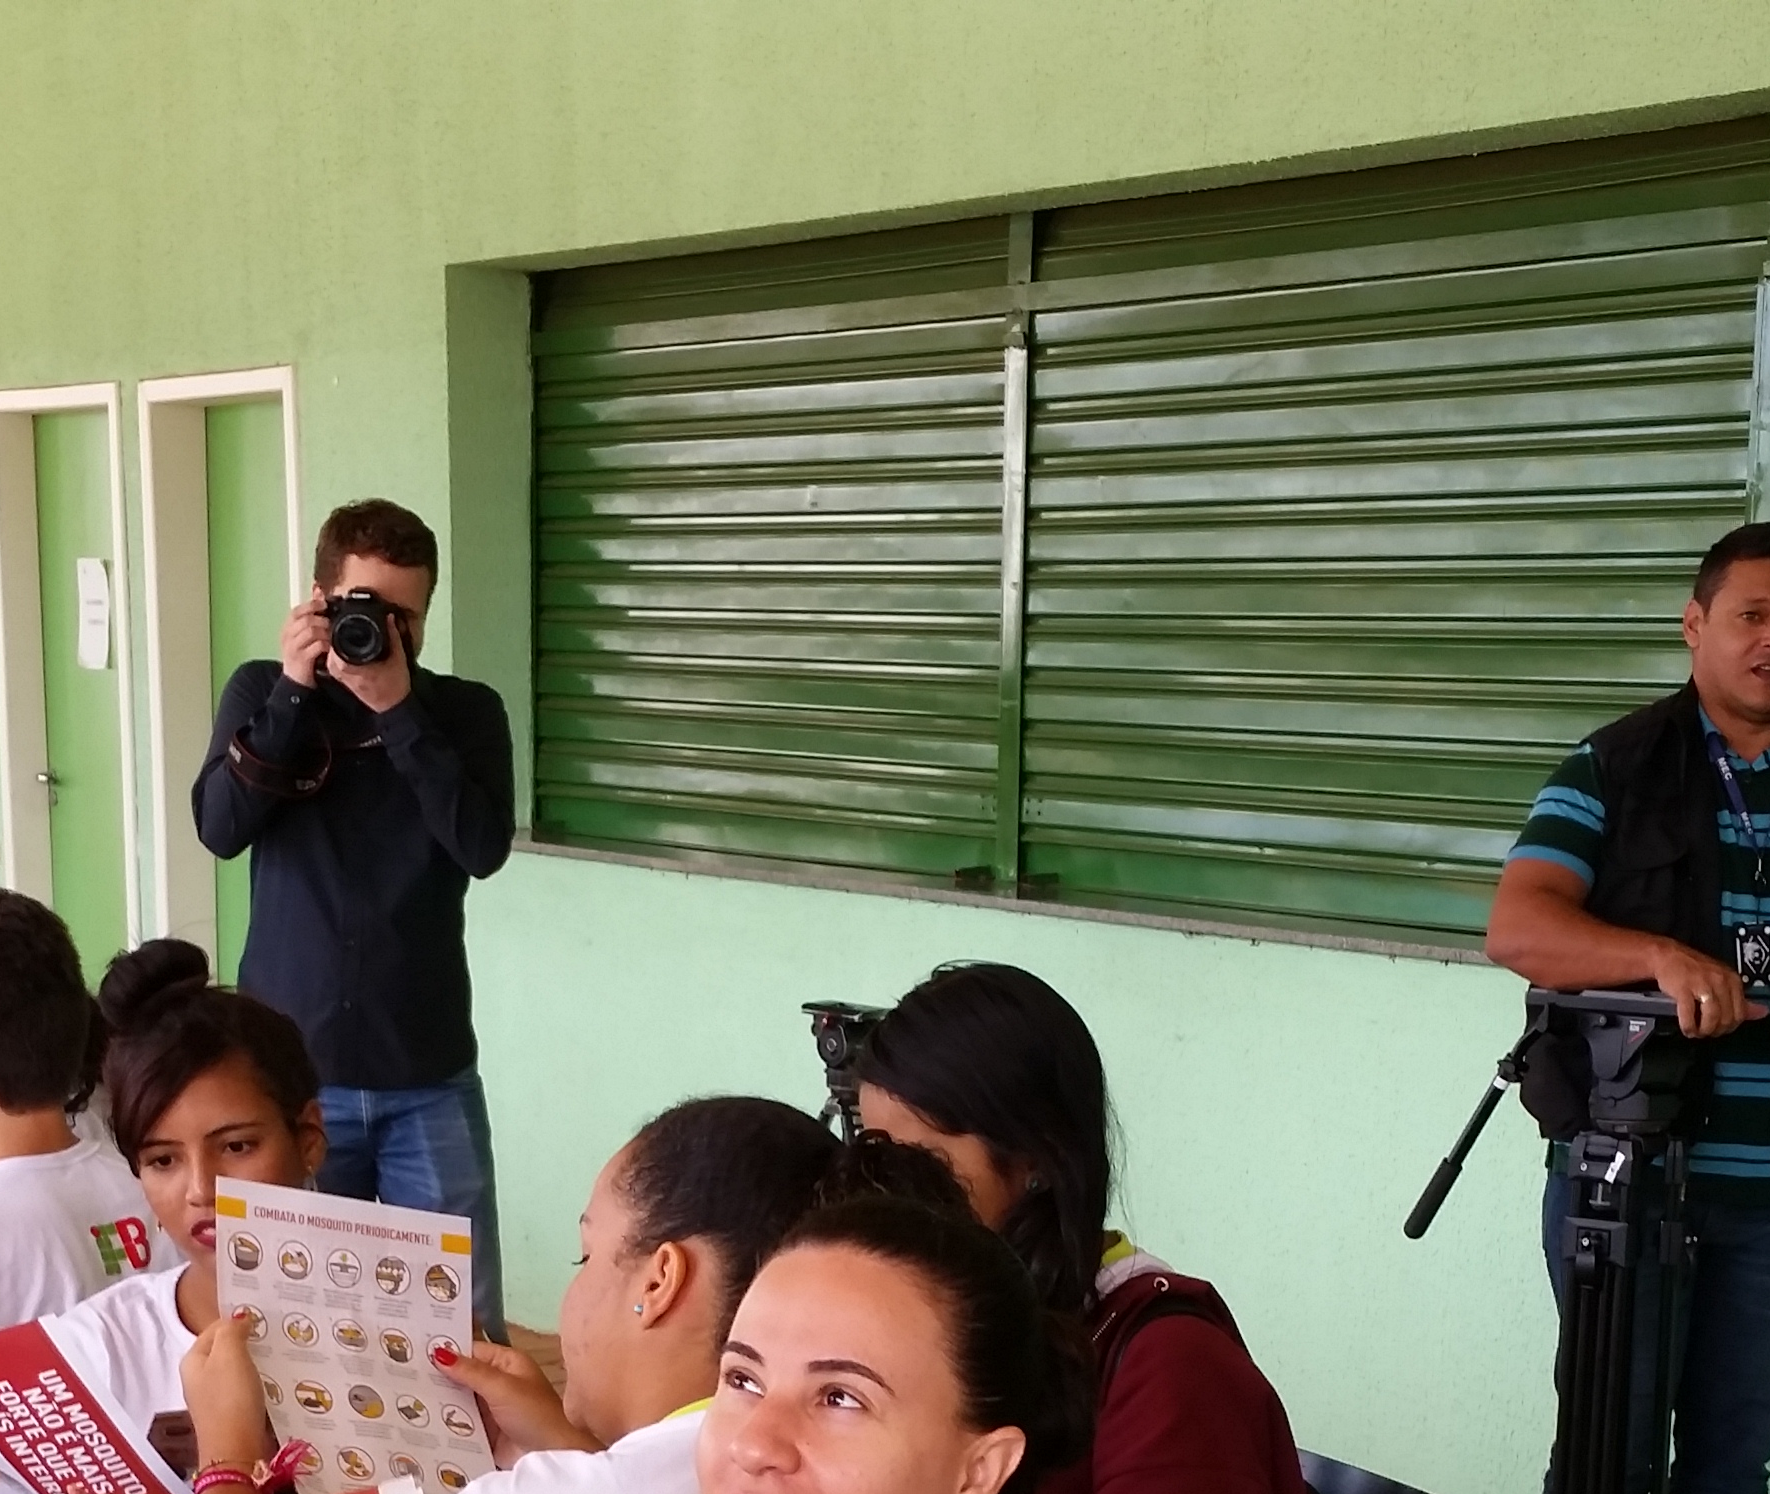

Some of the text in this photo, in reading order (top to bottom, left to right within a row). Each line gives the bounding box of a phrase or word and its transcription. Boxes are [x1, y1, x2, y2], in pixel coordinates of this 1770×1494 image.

[1717, 757, 1732, 781] MEC
[253, 1205, 296, 1224] COMBATA
[298, 1213, 305, 1225] O
[307, 1216, 353, 1233] MOSQUITO
[38, 1368, 67, 1400] UM
[21, 1386, 65, 1431] NÃO
[54, 1429, 81, 1446] É
[36, 1441, 77, 1482] QUE
